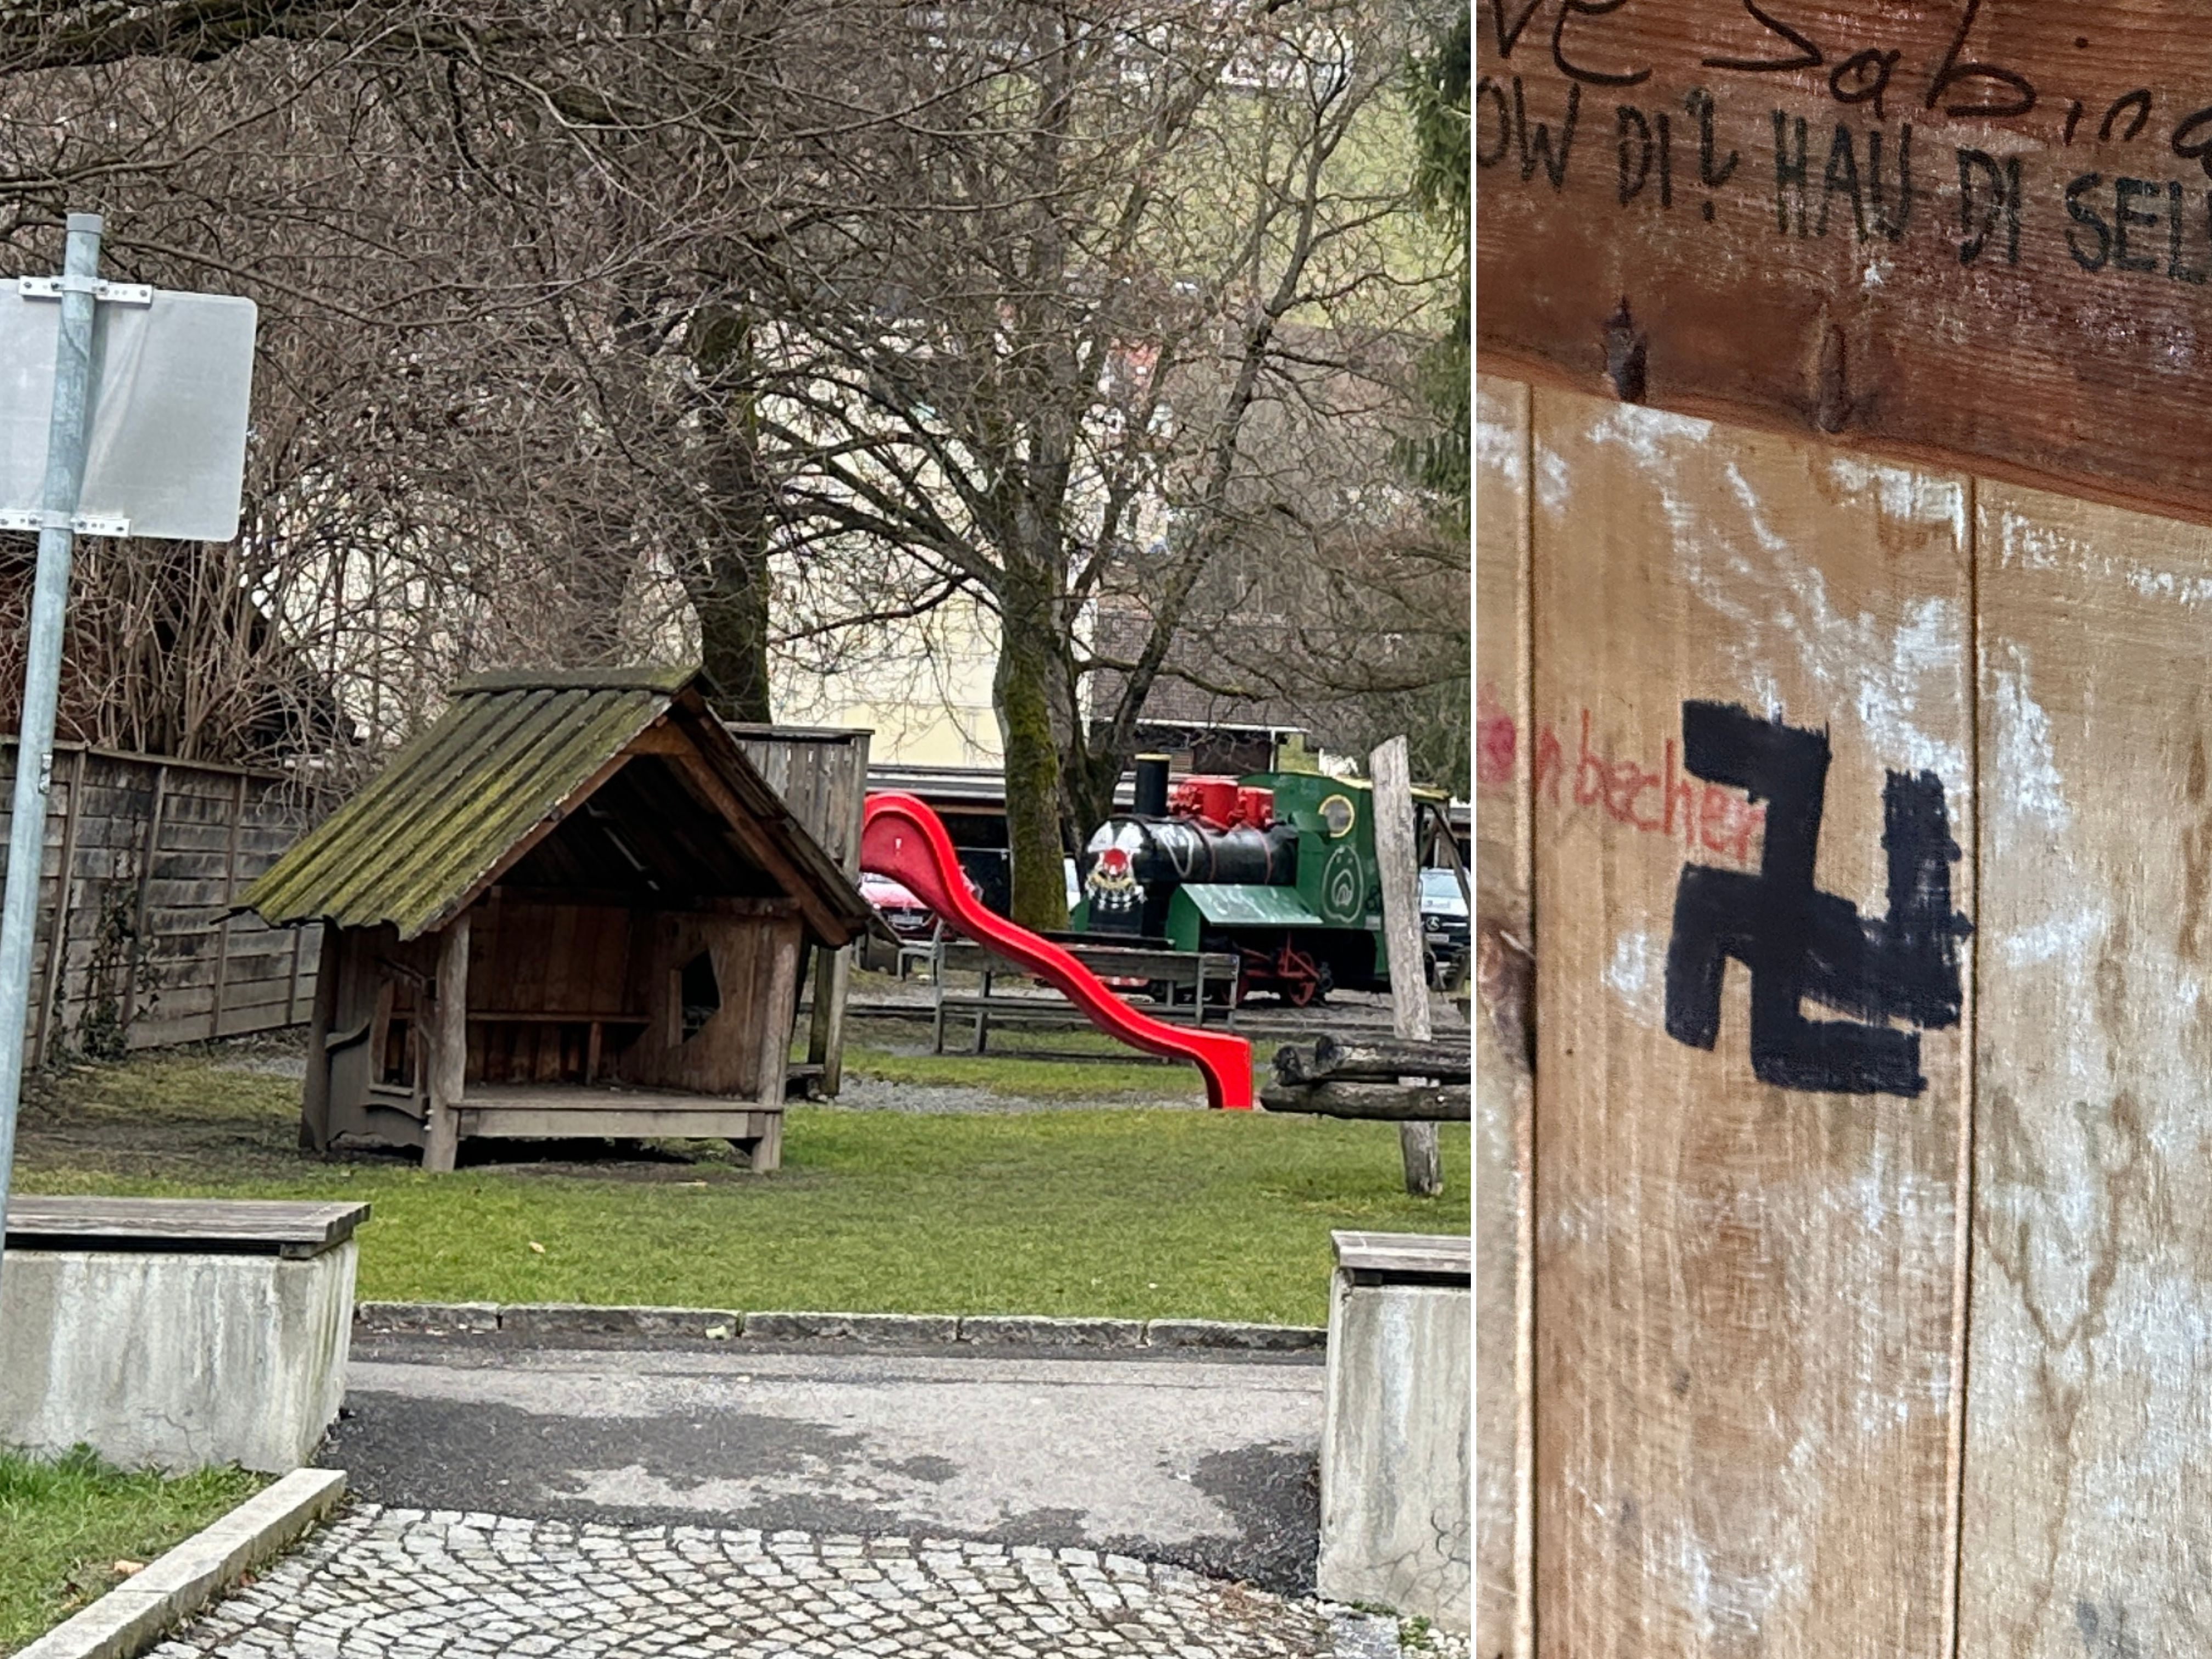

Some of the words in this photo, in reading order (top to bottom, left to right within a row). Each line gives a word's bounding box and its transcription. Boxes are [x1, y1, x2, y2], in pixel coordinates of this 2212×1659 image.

[1773, 109, 1913, 245] HAU
[1956, 145, 2021, 268] DI
[2065, 172, 2212, 286] SEL
